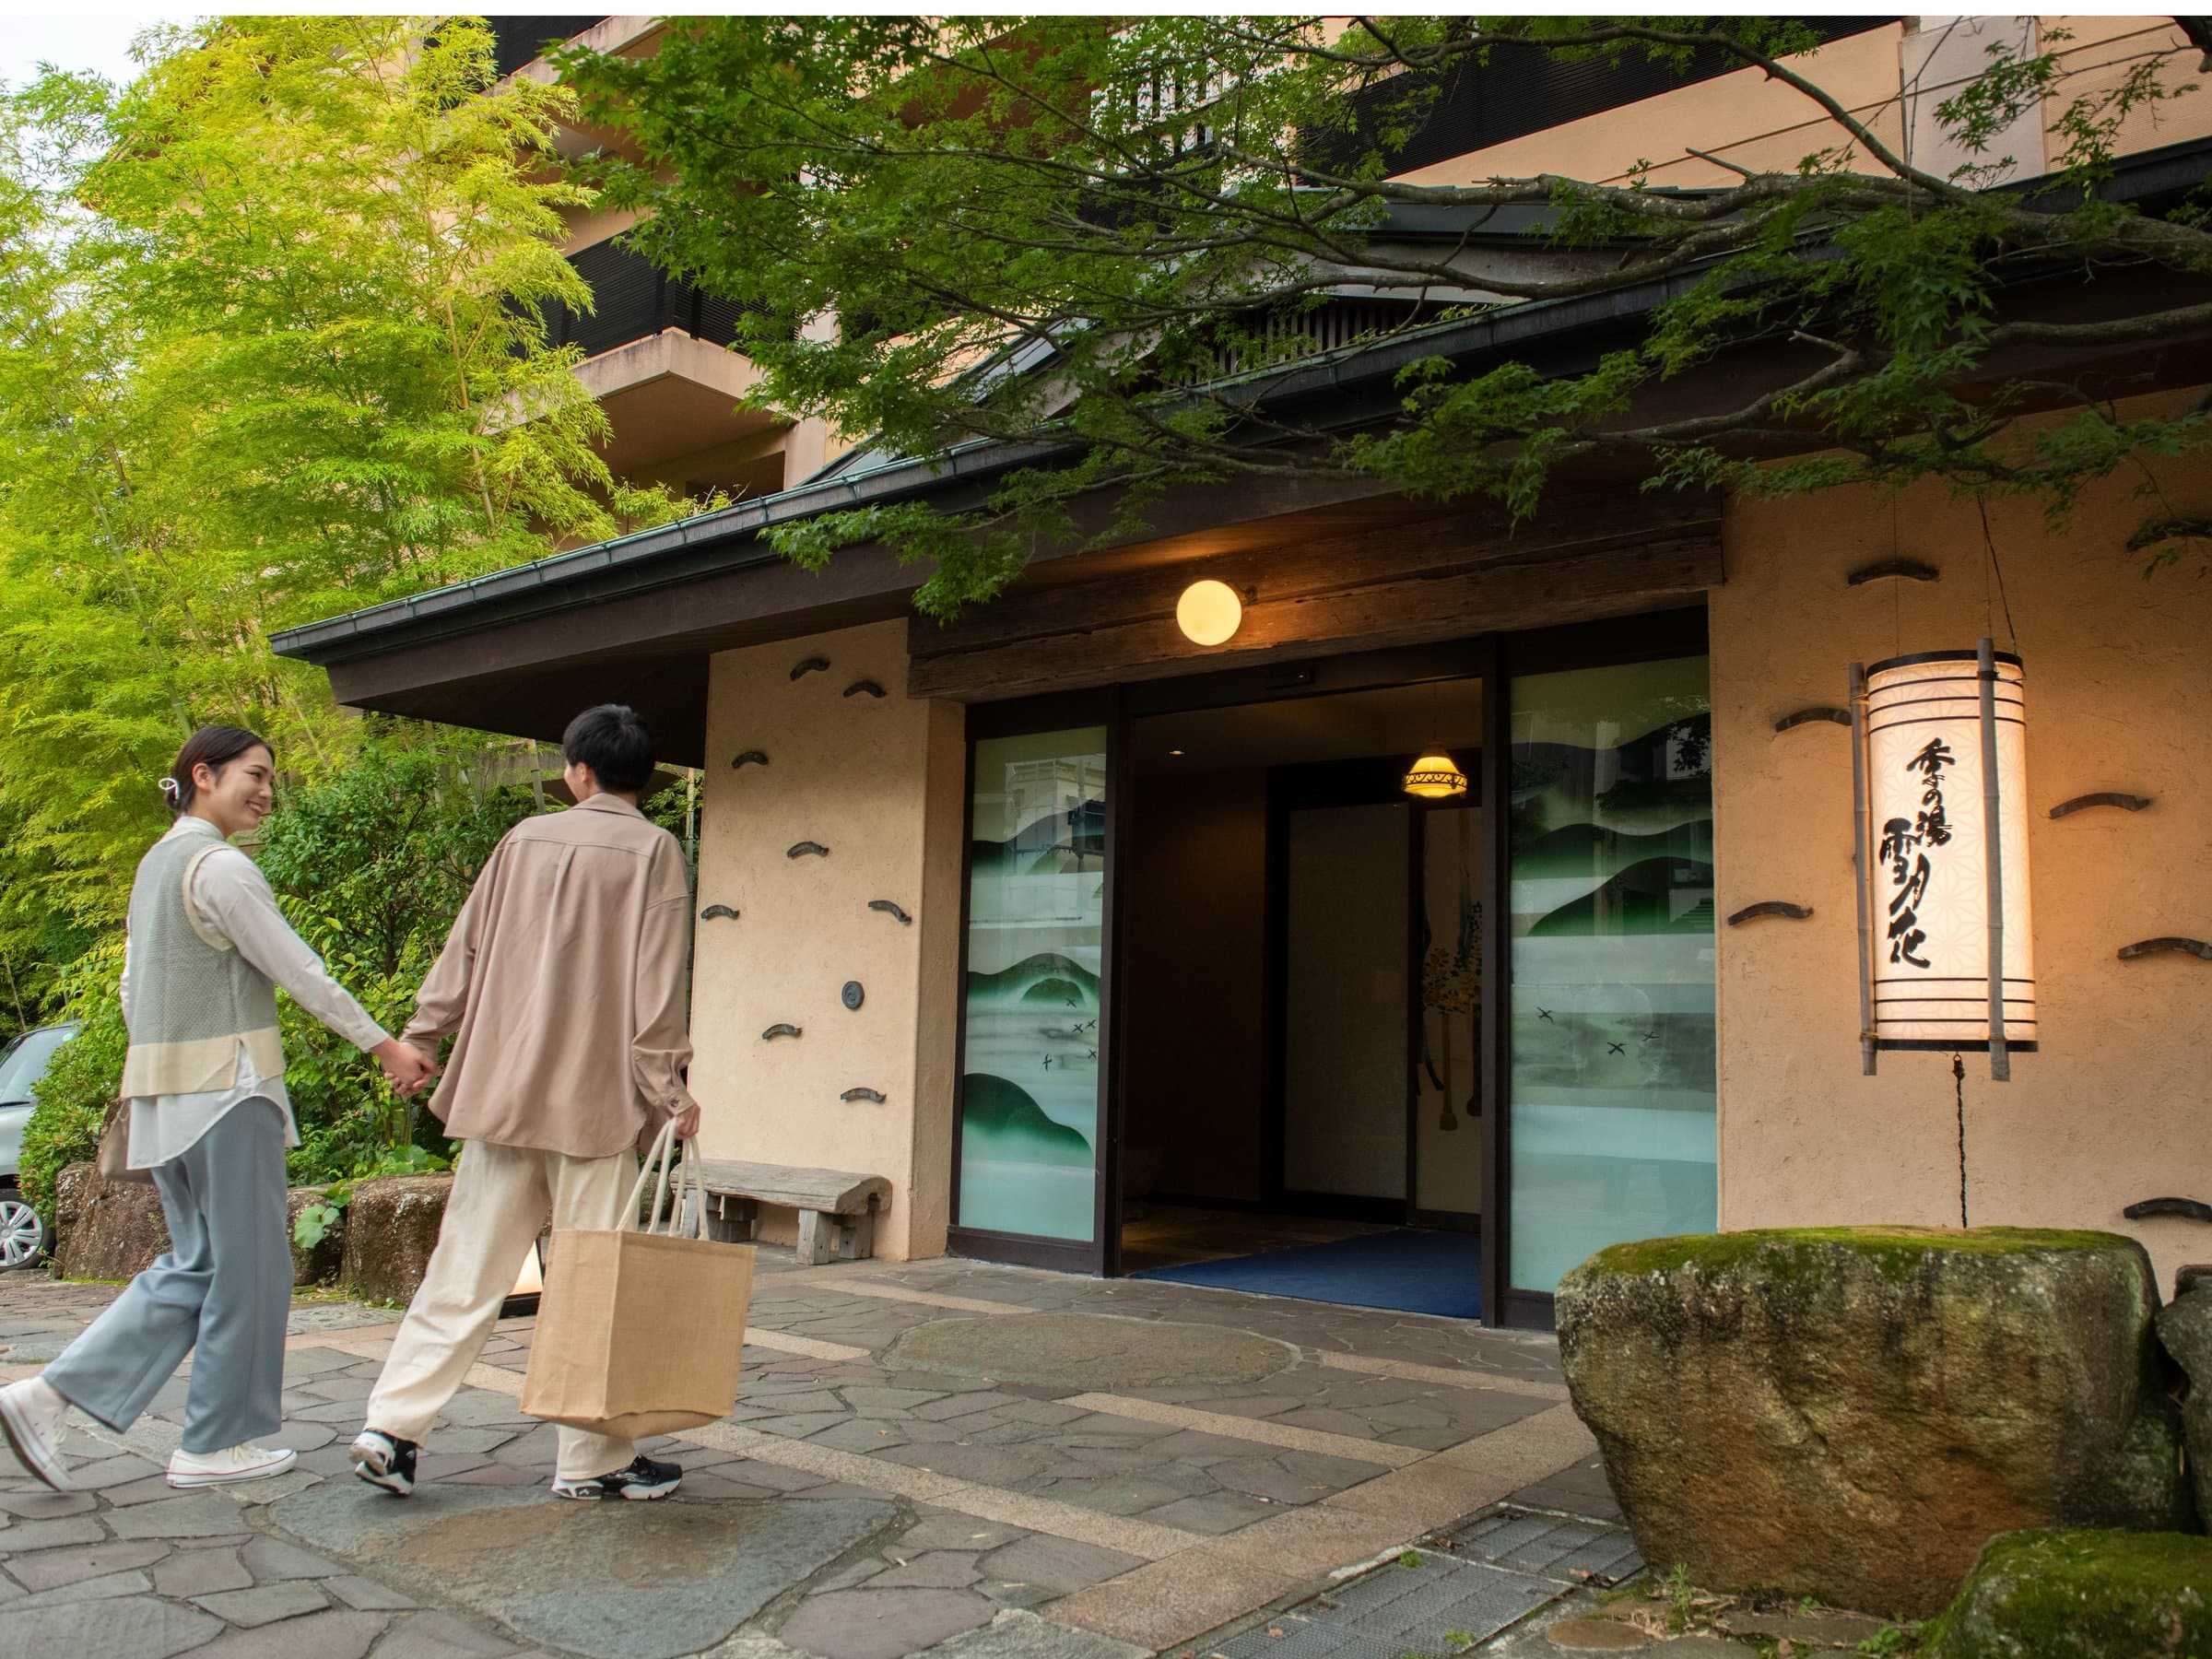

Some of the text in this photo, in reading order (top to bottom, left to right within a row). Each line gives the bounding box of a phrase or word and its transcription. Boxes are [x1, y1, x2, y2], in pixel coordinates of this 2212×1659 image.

[1906, 737, 1956, 847] 季の湯
[1878, 818, 1931, 969] 雪月花
